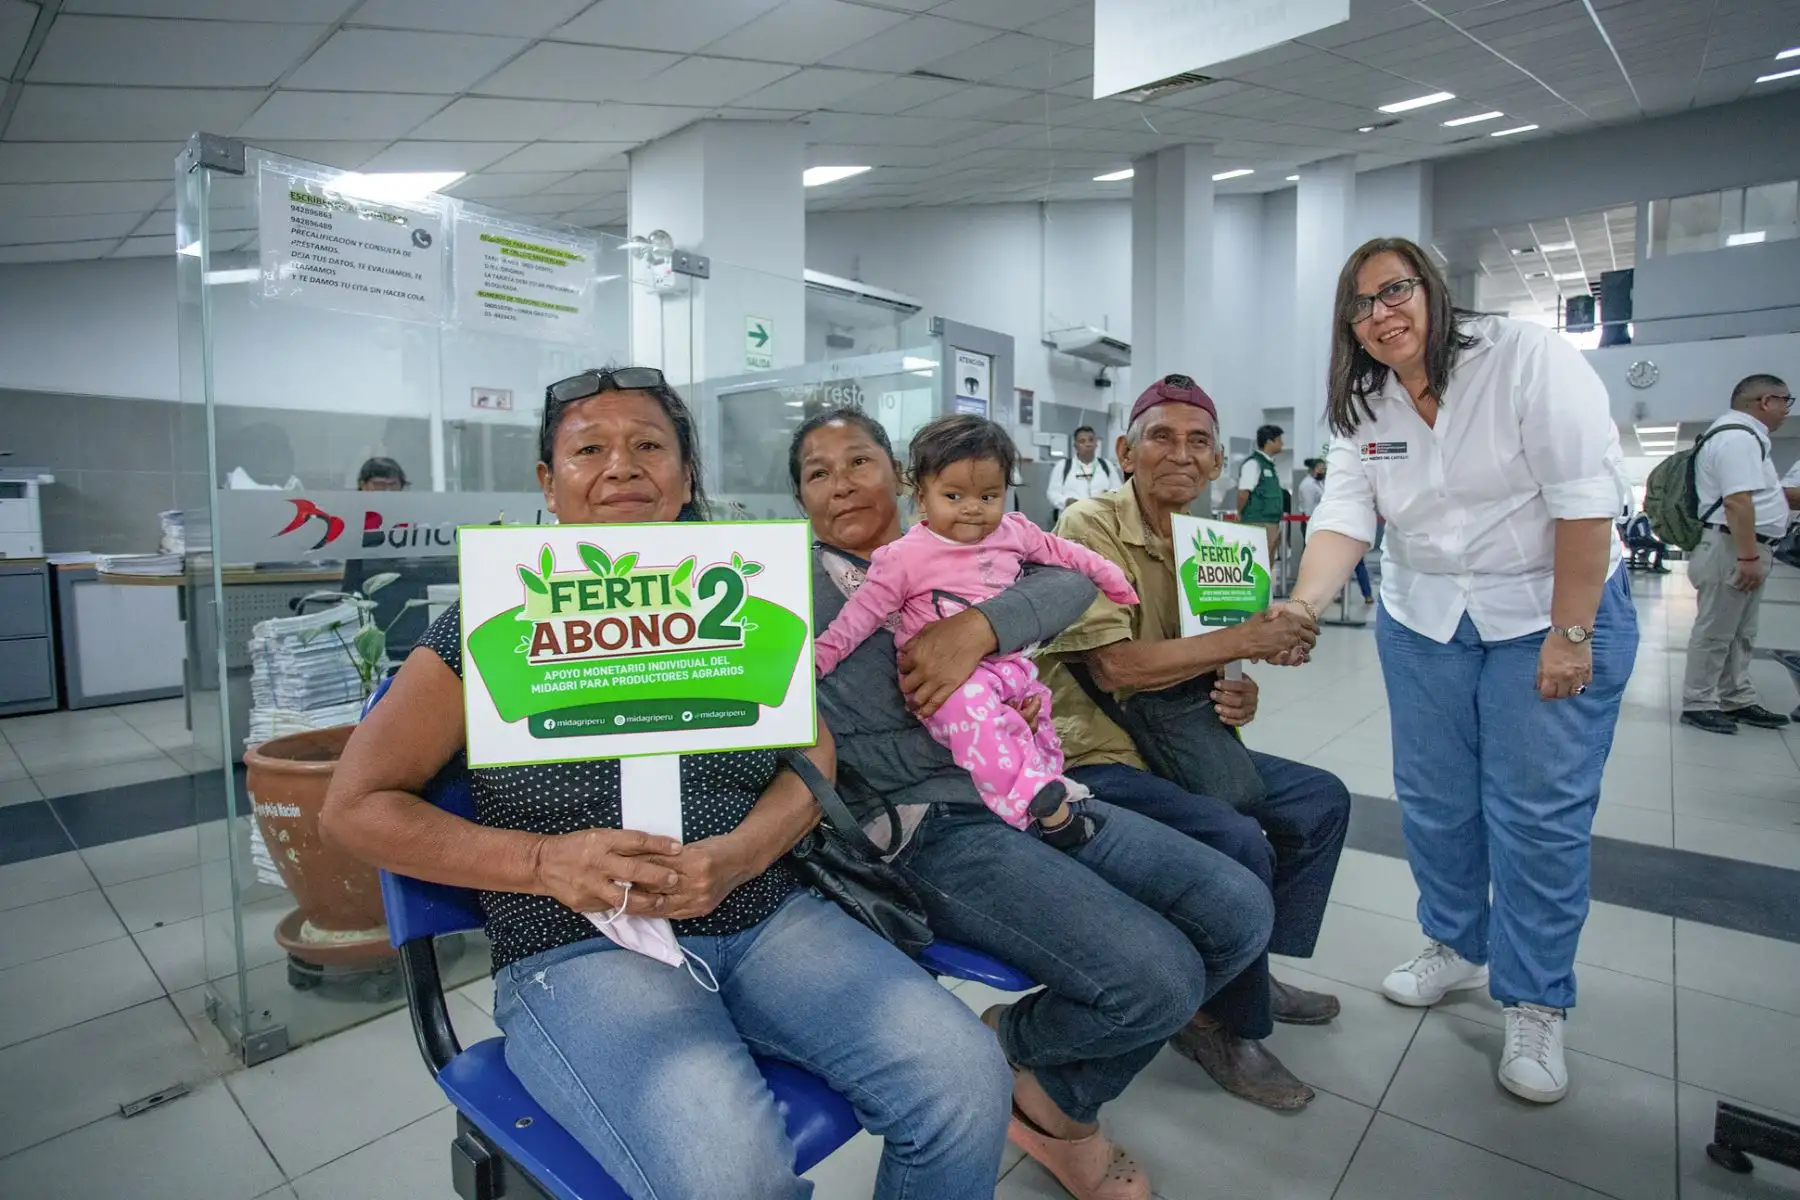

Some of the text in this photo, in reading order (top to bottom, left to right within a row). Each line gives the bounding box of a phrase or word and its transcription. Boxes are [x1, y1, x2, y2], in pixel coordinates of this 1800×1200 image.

[313, 254, 327, 263] TUS
[358, 262, 367, 270] TE
[414, 272, 423, 281] TE
[402, 250, 412, 258] DE
[299, 274, 309, 282] TE
[309, 276, 339, 287] DAMOS
[341, 281, 351, 289] TU
[352, 284, 369, 292] CITA
[370, 286, 381, 294] SIN
[383, 289, 406, 298] HACER
[362, 511, 457, 549] Banc
[1198, 546, 1254, 584] ABONO 2
[1201, 546, 1235, 563] FERTI
[549, 573, 674, 614] FERTI
[530, 566, 745, 657] ABONO 2
[530, 664, 745, 695] MIDAGRI PARA PRODUCTORES AGRARIOS
[544, 655, 731, 682] APOYO MONETARIO INDIVIDUAL DEL
[556, 717, 606, 730] midagriperu
[626, 713, 674, 727] midagriperu
